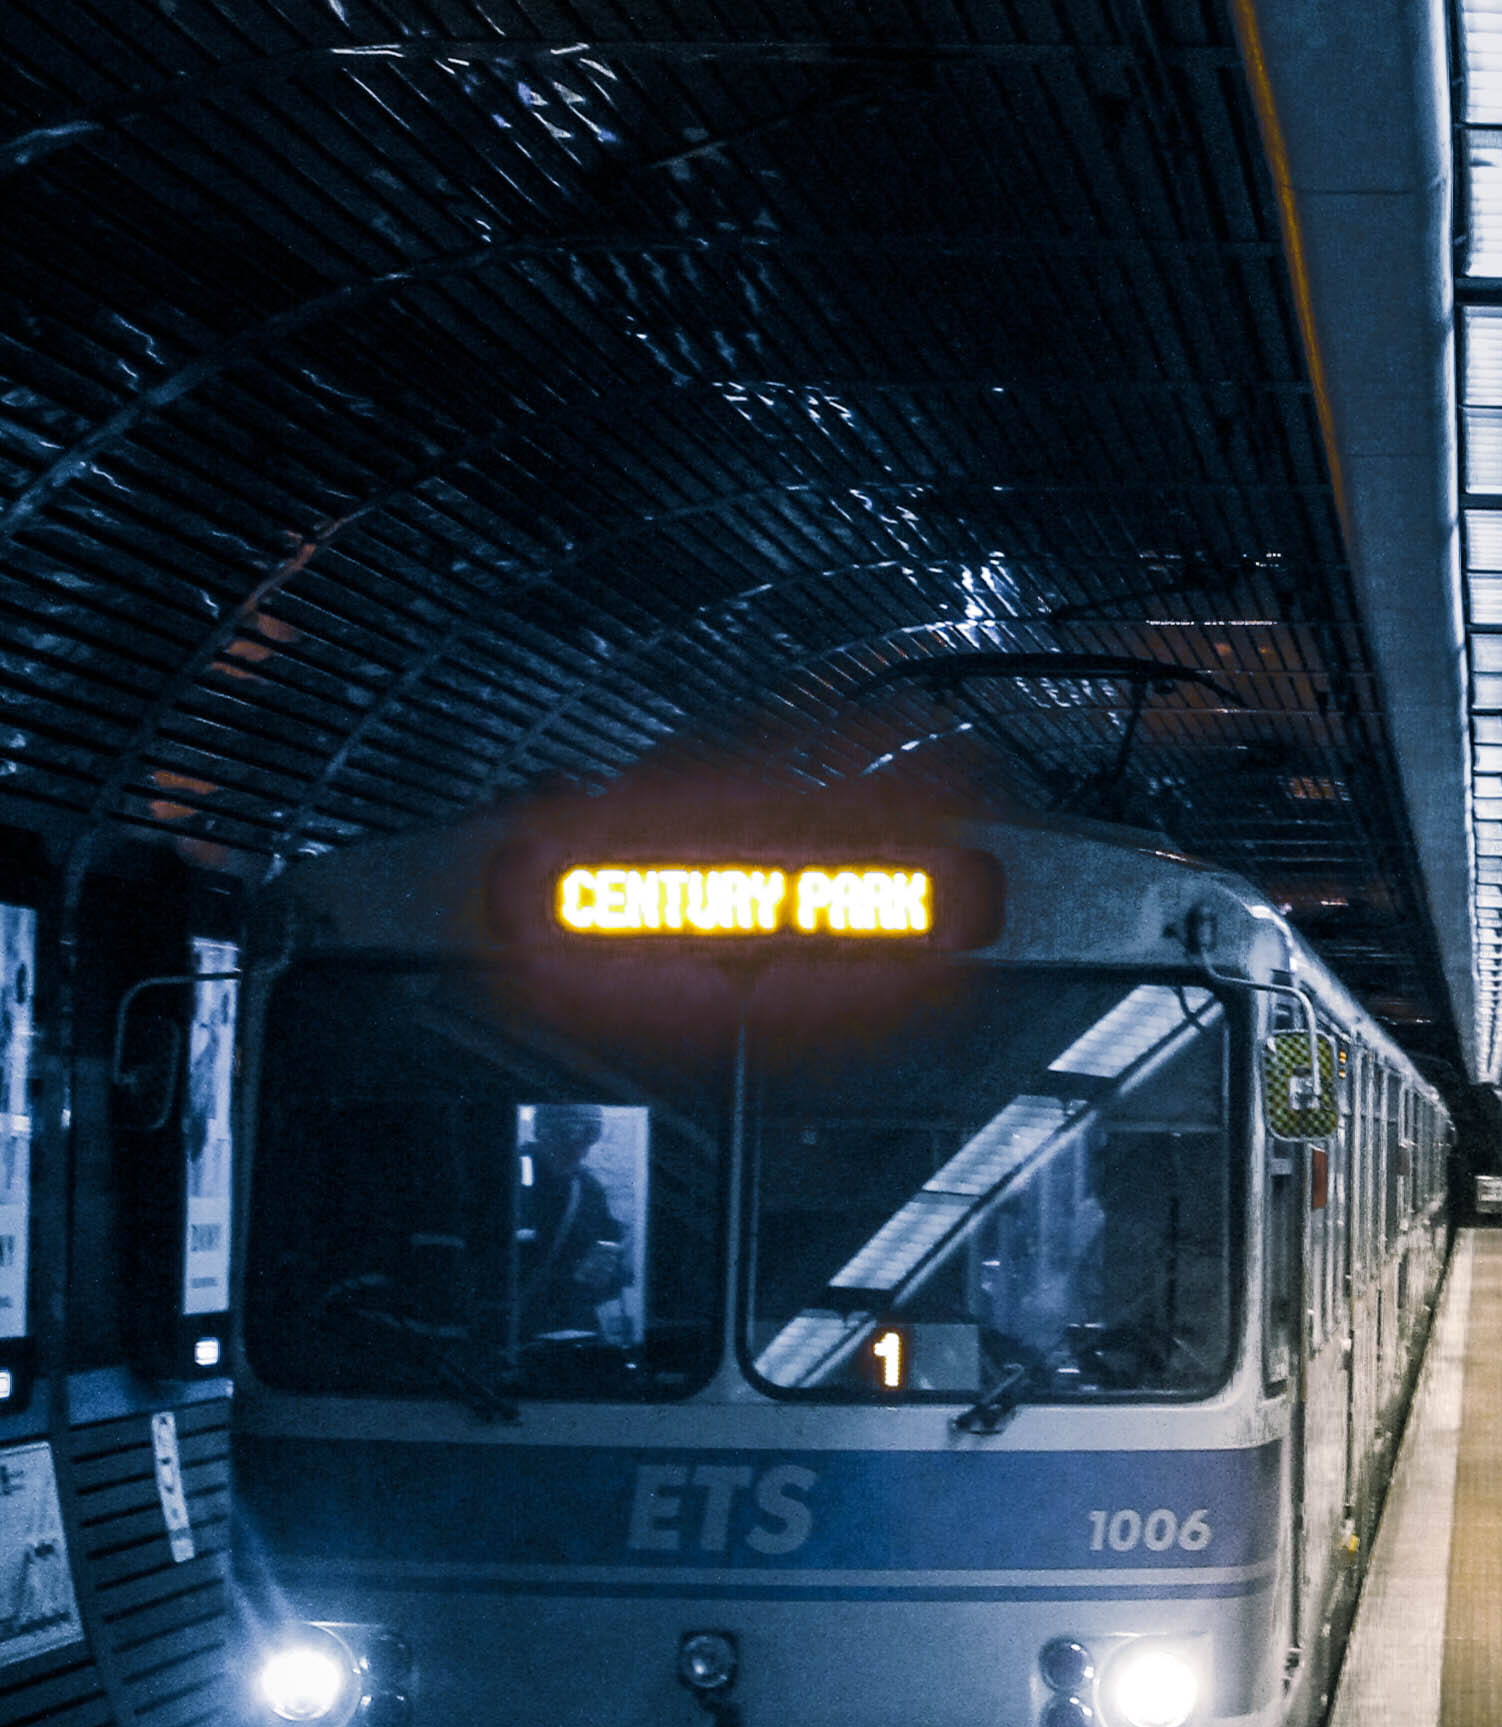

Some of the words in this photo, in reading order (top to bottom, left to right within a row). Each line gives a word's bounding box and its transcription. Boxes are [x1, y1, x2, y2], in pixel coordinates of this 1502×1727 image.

[559, 866, 785, 931] CENTURY
[796, 866, 929, 931] PARK
[873, 1331, 901, 1387] 1
[627, 1464, 817, 1555] ETS
[1088, 1508, 1212, 1552] 1006
